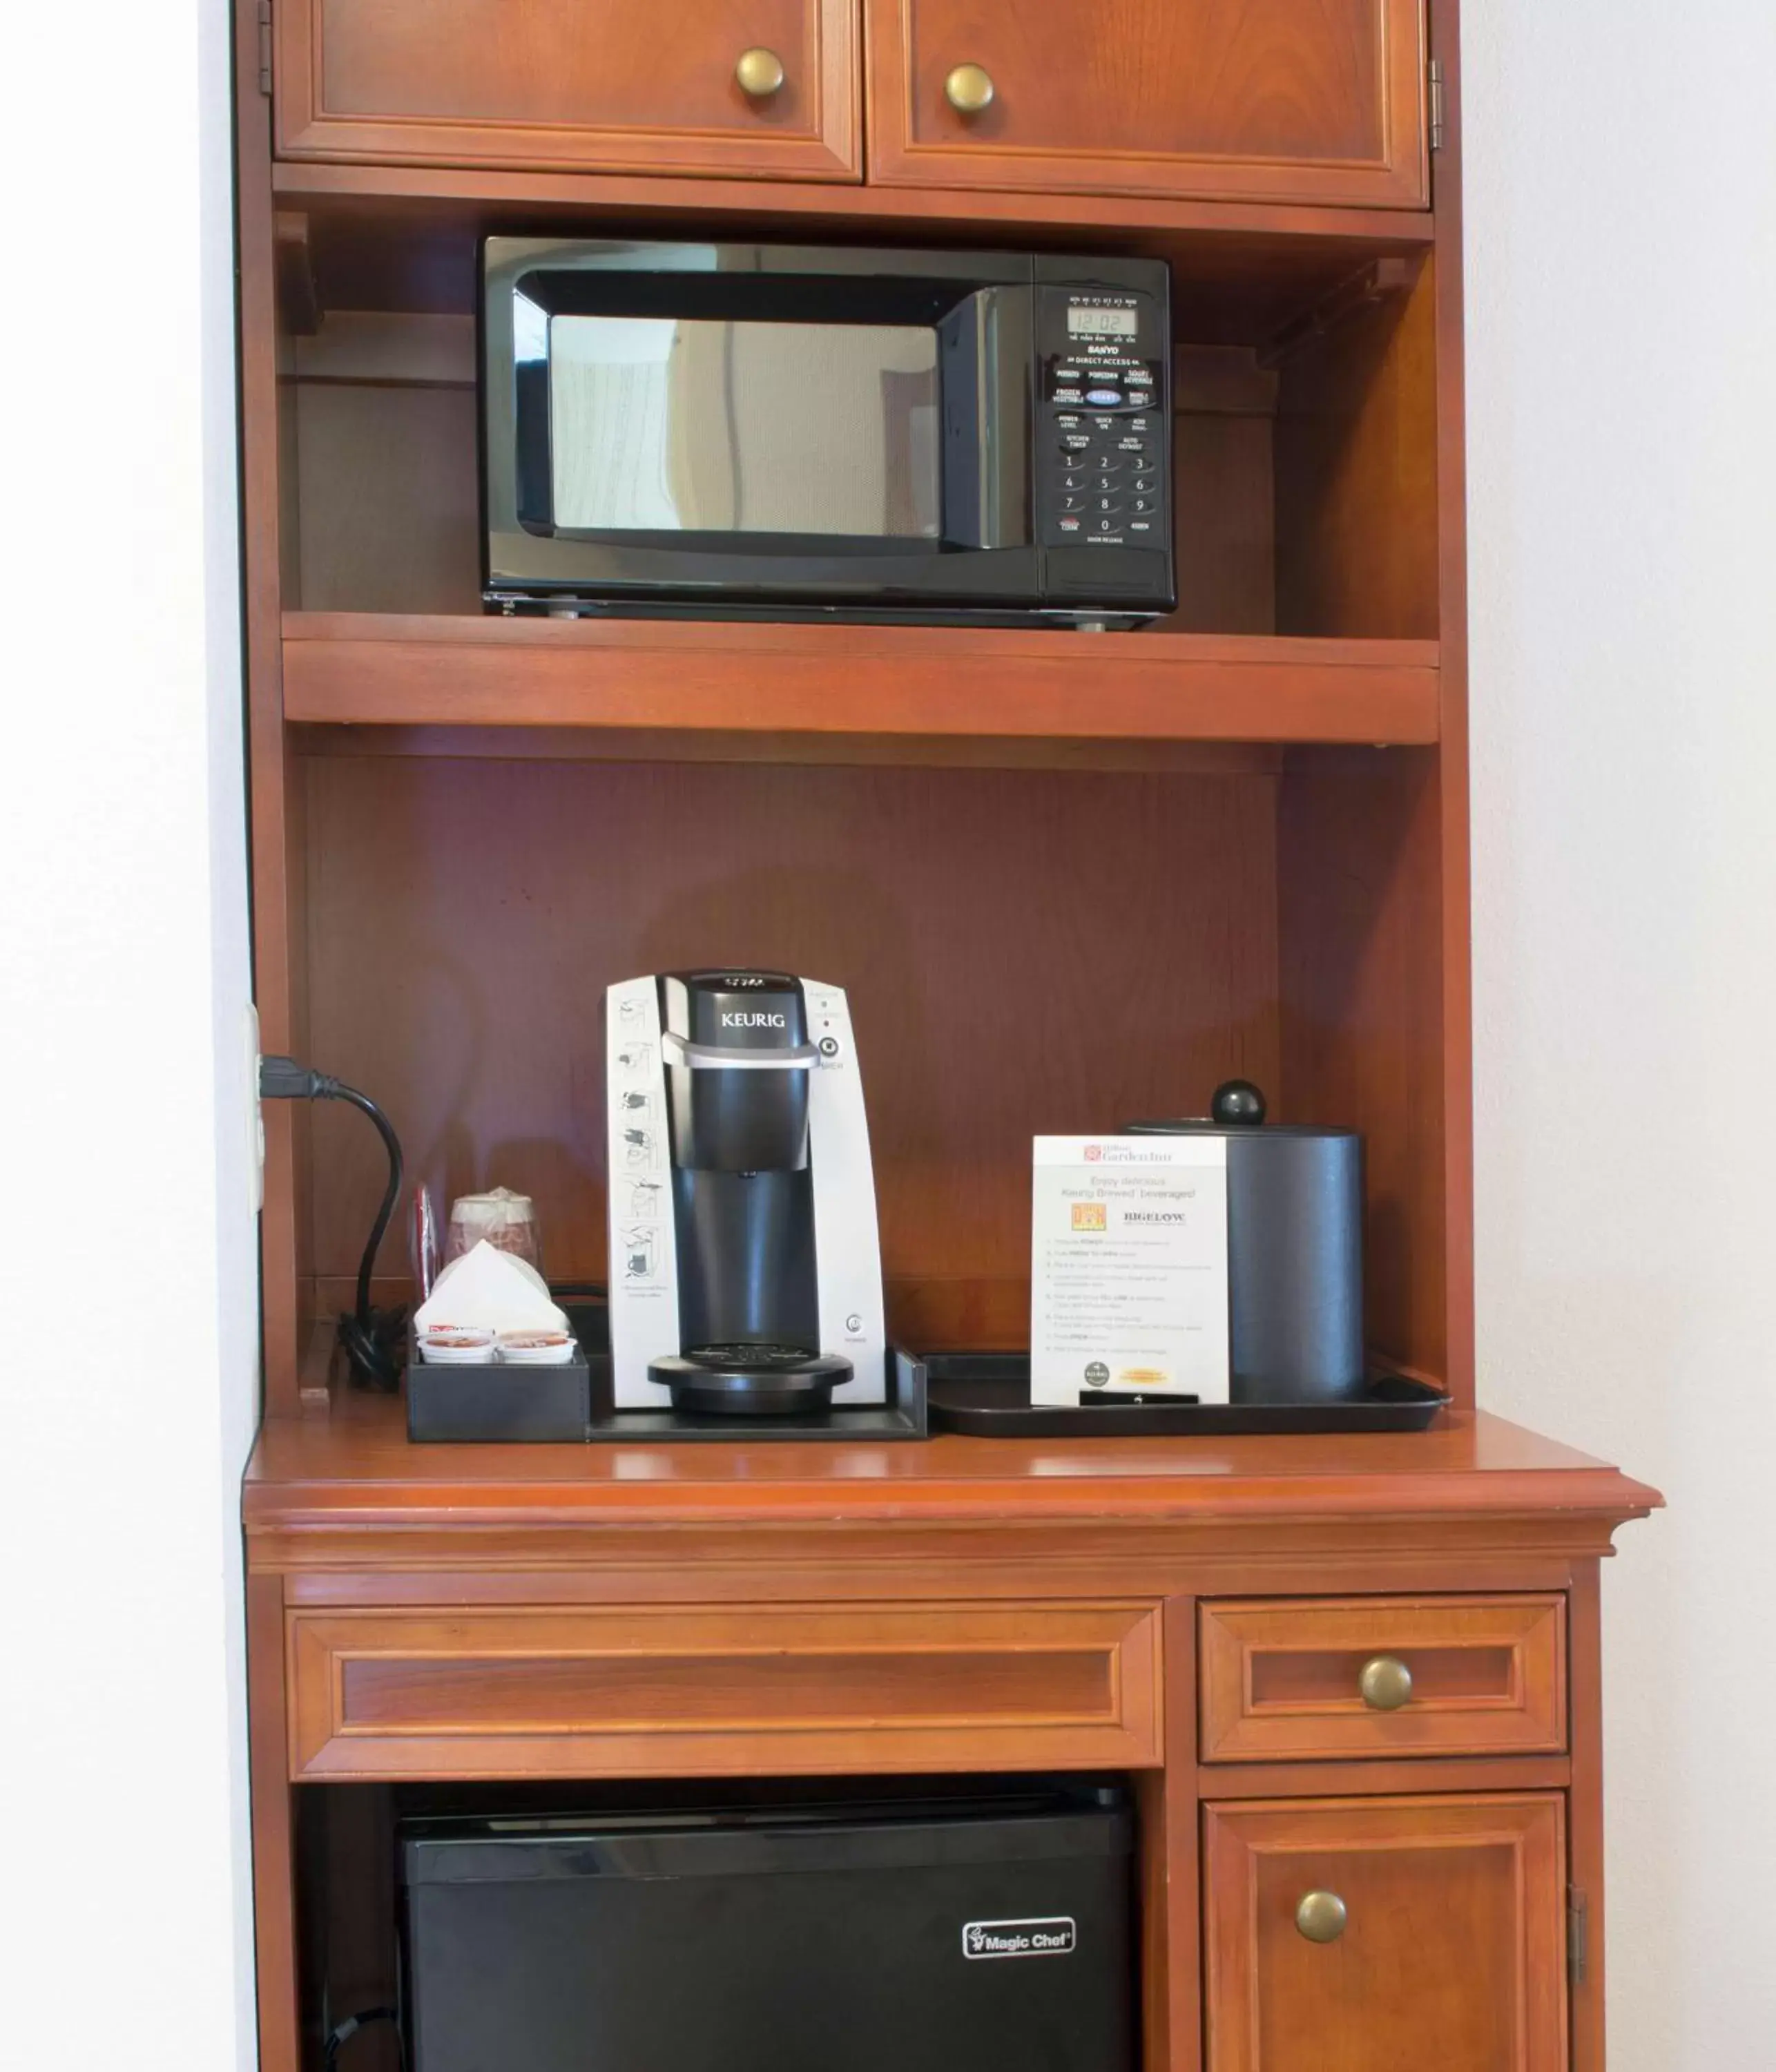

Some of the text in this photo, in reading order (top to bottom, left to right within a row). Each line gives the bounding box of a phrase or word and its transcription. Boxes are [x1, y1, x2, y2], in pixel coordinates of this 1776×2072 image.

[1088, 345, 1119, 355] SANYO
[1066, 457, 1072, 466] 1
[1101, 457, 1108, 468] 2
[1137, 459, 1143, 469] 3
[1065, 477, 1072, 487] 4
[1101, 479, 1108, 488] 5
[1137, 479, 1143, 490] 6
[1066, 497, 1072, 508] 7
[1102, 499, 1108, 509] 8
[1137, 500, 1143, 510] 9
[1101, 520, 1108, 530] 0
[722, 1013, 785, 1028] KEURIG
[1123, 1211, 1186, 1222] BIGELOW
[986, 1936, 1029, 1950] Magic
